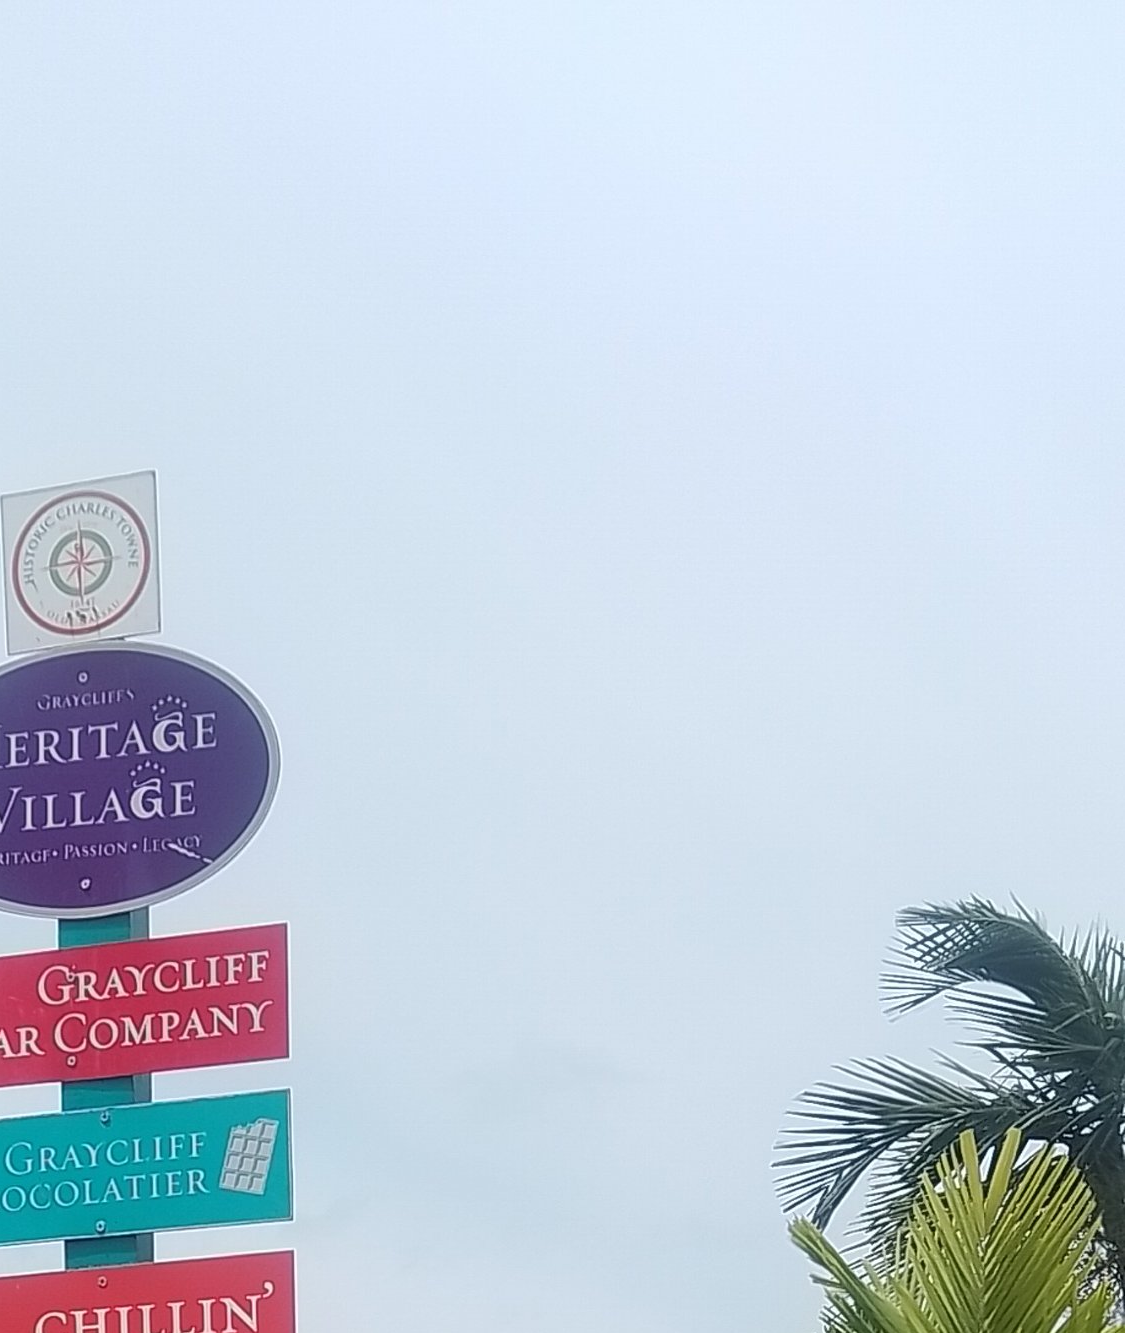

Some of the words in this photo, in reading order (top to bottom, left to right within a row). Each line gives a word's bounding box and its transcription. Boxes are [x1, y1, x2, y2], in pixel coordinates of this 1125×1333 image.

[23, 516, 56, 587] HISTORIC
[56, 502, 115, 521] CHARLES
[116, 516, 139, 568] TOWNE
[64, 841, 128, 859] PASSION
[143, 834, 202, 852] LEGACY
[37, 949, 270, 1006] GRAYCLIFF
[53, 1000, 273, 1054] COMPANY
[4, 1131, 207, 1176] GRAYCLIFF
